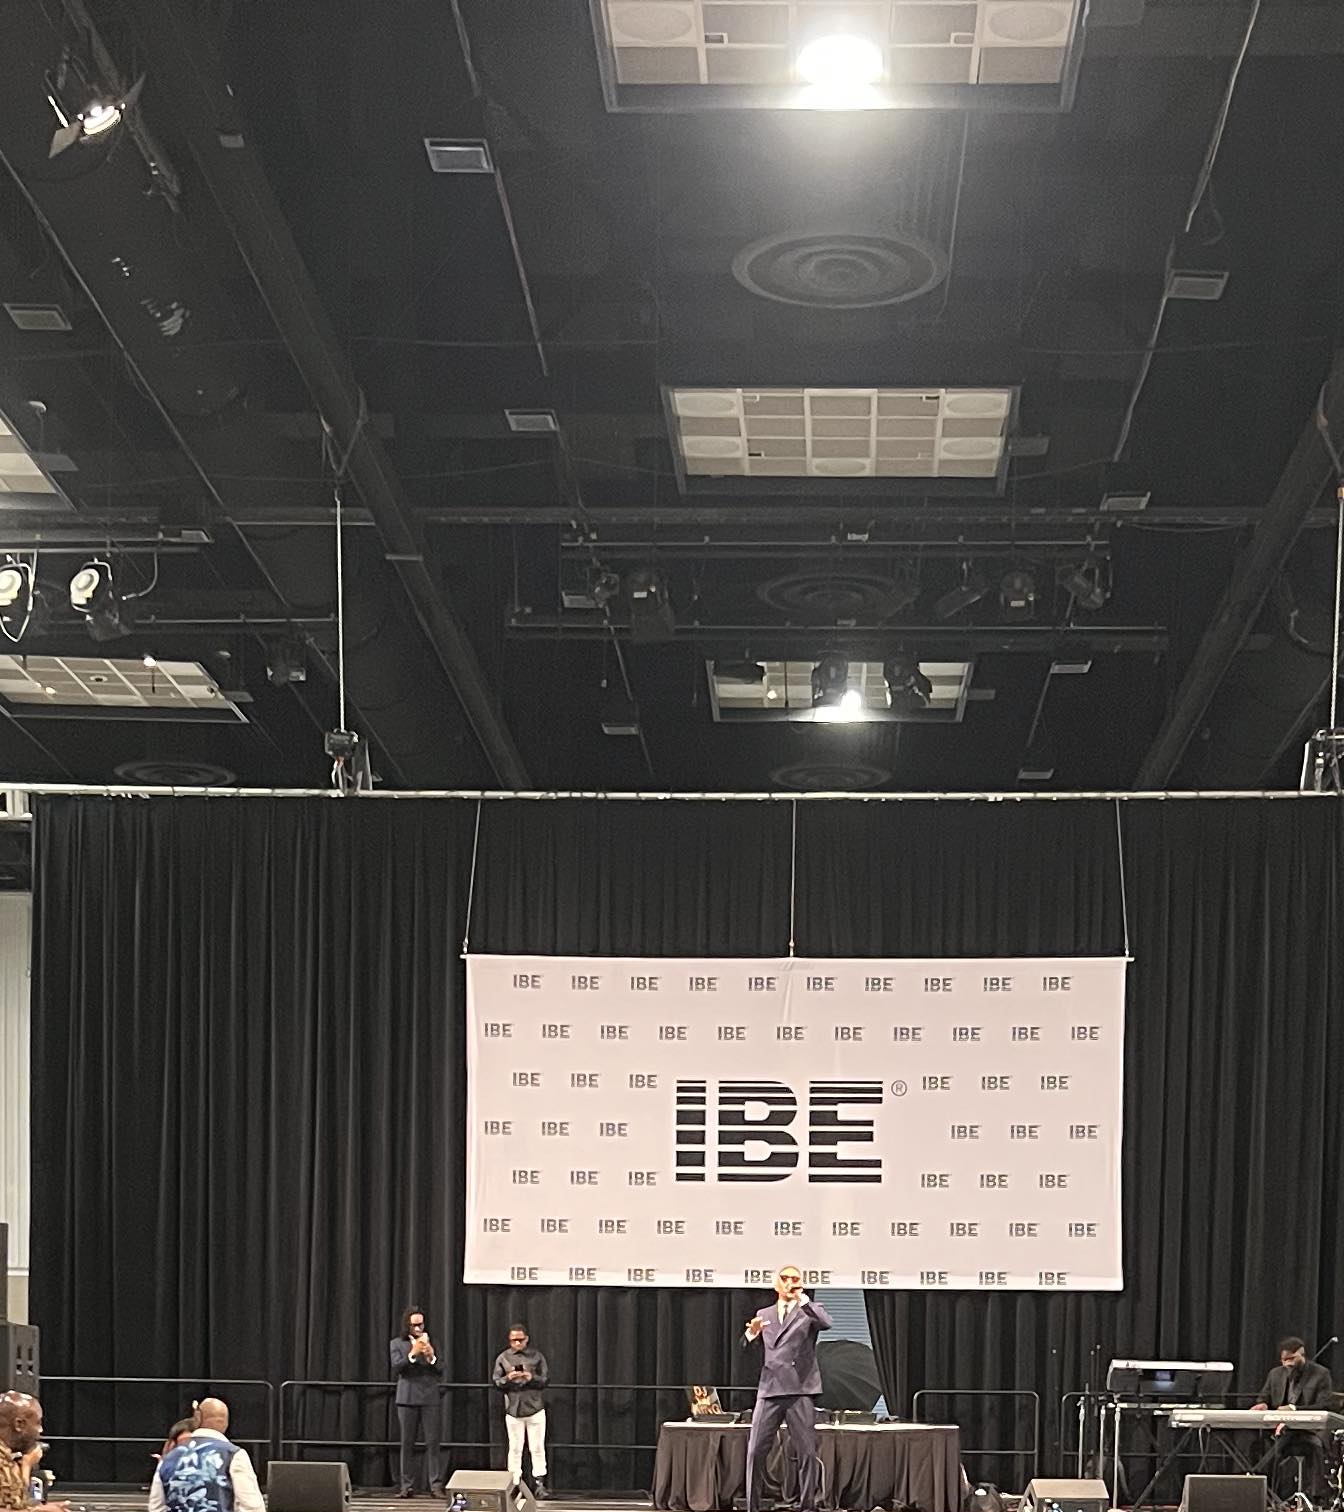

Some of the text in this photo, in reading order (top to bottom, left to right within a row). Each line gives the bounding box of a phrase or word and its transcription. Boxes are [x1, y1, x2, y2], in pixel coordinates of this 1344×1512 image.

[512, 974, 1072, 993] IBE IBE IBE IBE IBE IBE IBE IBE IBE IBE
[484, 1022, 1101, 1042] IBE IBE IBE IBE IBE IBE IBE IBE IBE IBE IBE
[512, 1071, 658, 1089] IBE IBE IBE
[922, 1075, 1070, 1091] IBE IBE IBE
[484, 1120, 628, 1138] IBE IBE IBE
[675, 1079, 884, 1183] IBE
[950, 1124, 1098, 1140] IBE IBE IBE
[512, 1169, 657, 1186] IBE IBE IBE
[920, 1173, 1068, 1189] IBE IBE IBE
[483, 1217, 1097, 1238] IBE IBE IBE IBE IBE IBE IBE IBE IBE IBE IBE
[510, 1266, 1068, 1285] IBE IBE IBE IBE IBE IBE IBE IBE IBE IBE
